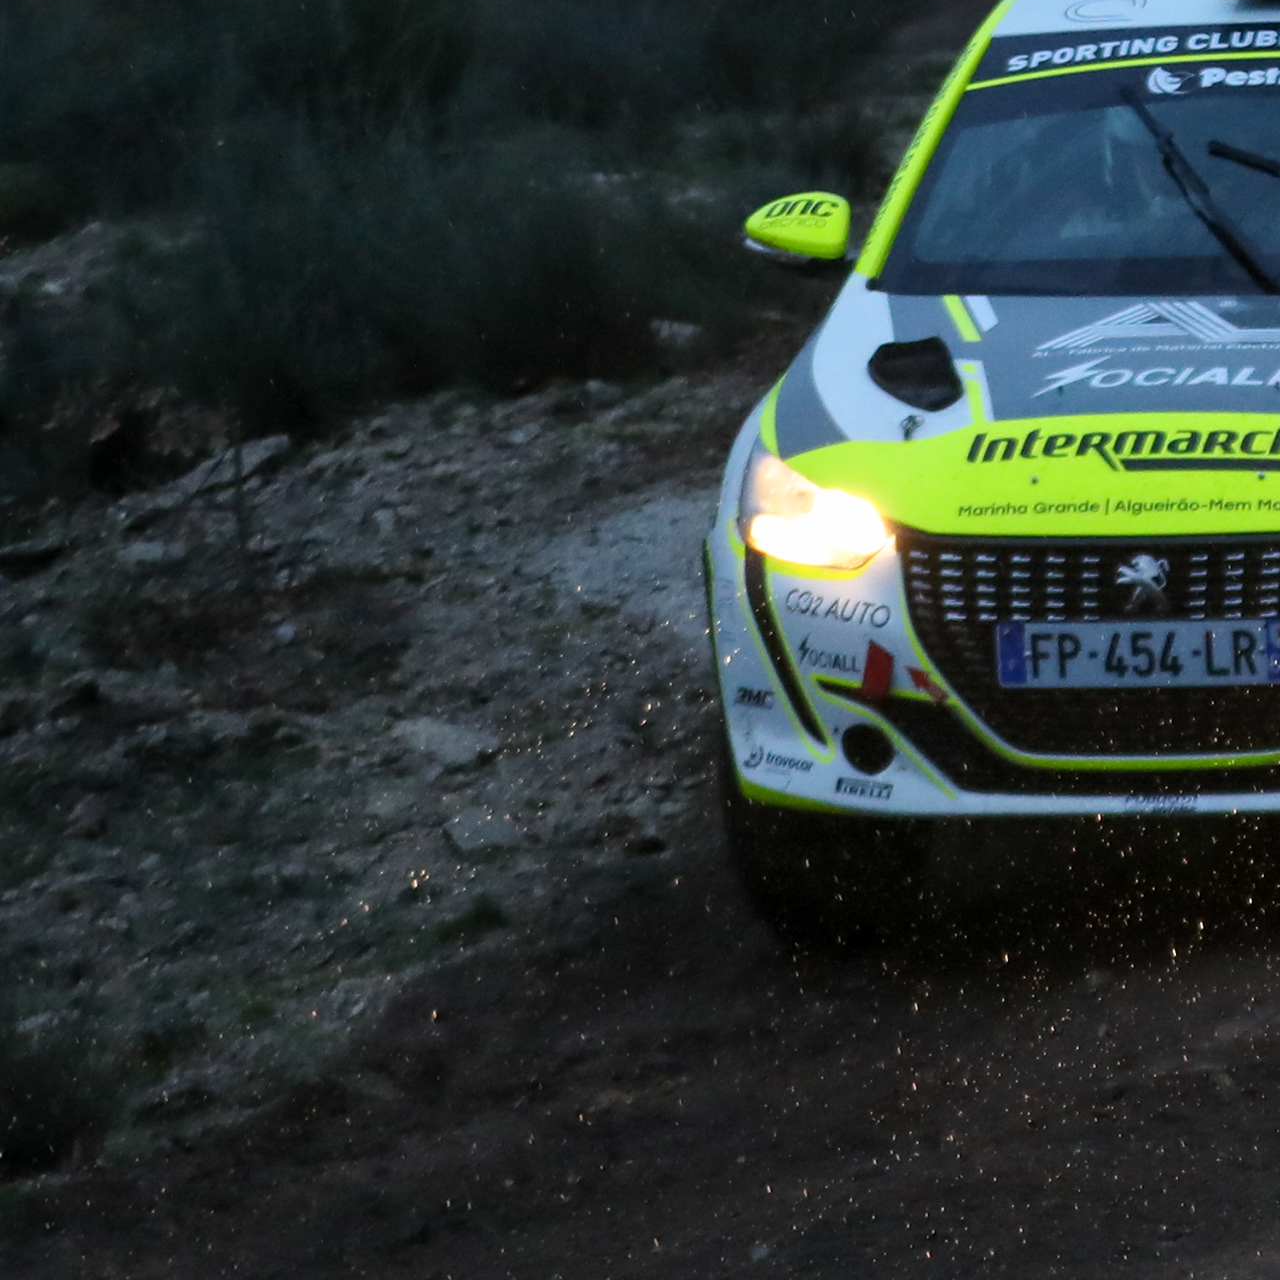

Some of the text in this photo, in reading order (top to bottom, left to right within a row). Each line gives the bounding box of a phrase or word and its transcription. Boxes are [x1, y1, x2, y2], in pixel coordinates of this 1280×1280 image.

[1007, 36, 1179, 71] SPORTING
[958, 502, 1028, 517] Marinha
[1033, 500, 1100, 515] Grande
[825, 598, 892, 628] AUTO
[1029, 629, 1259, 680] FP-454-LR
